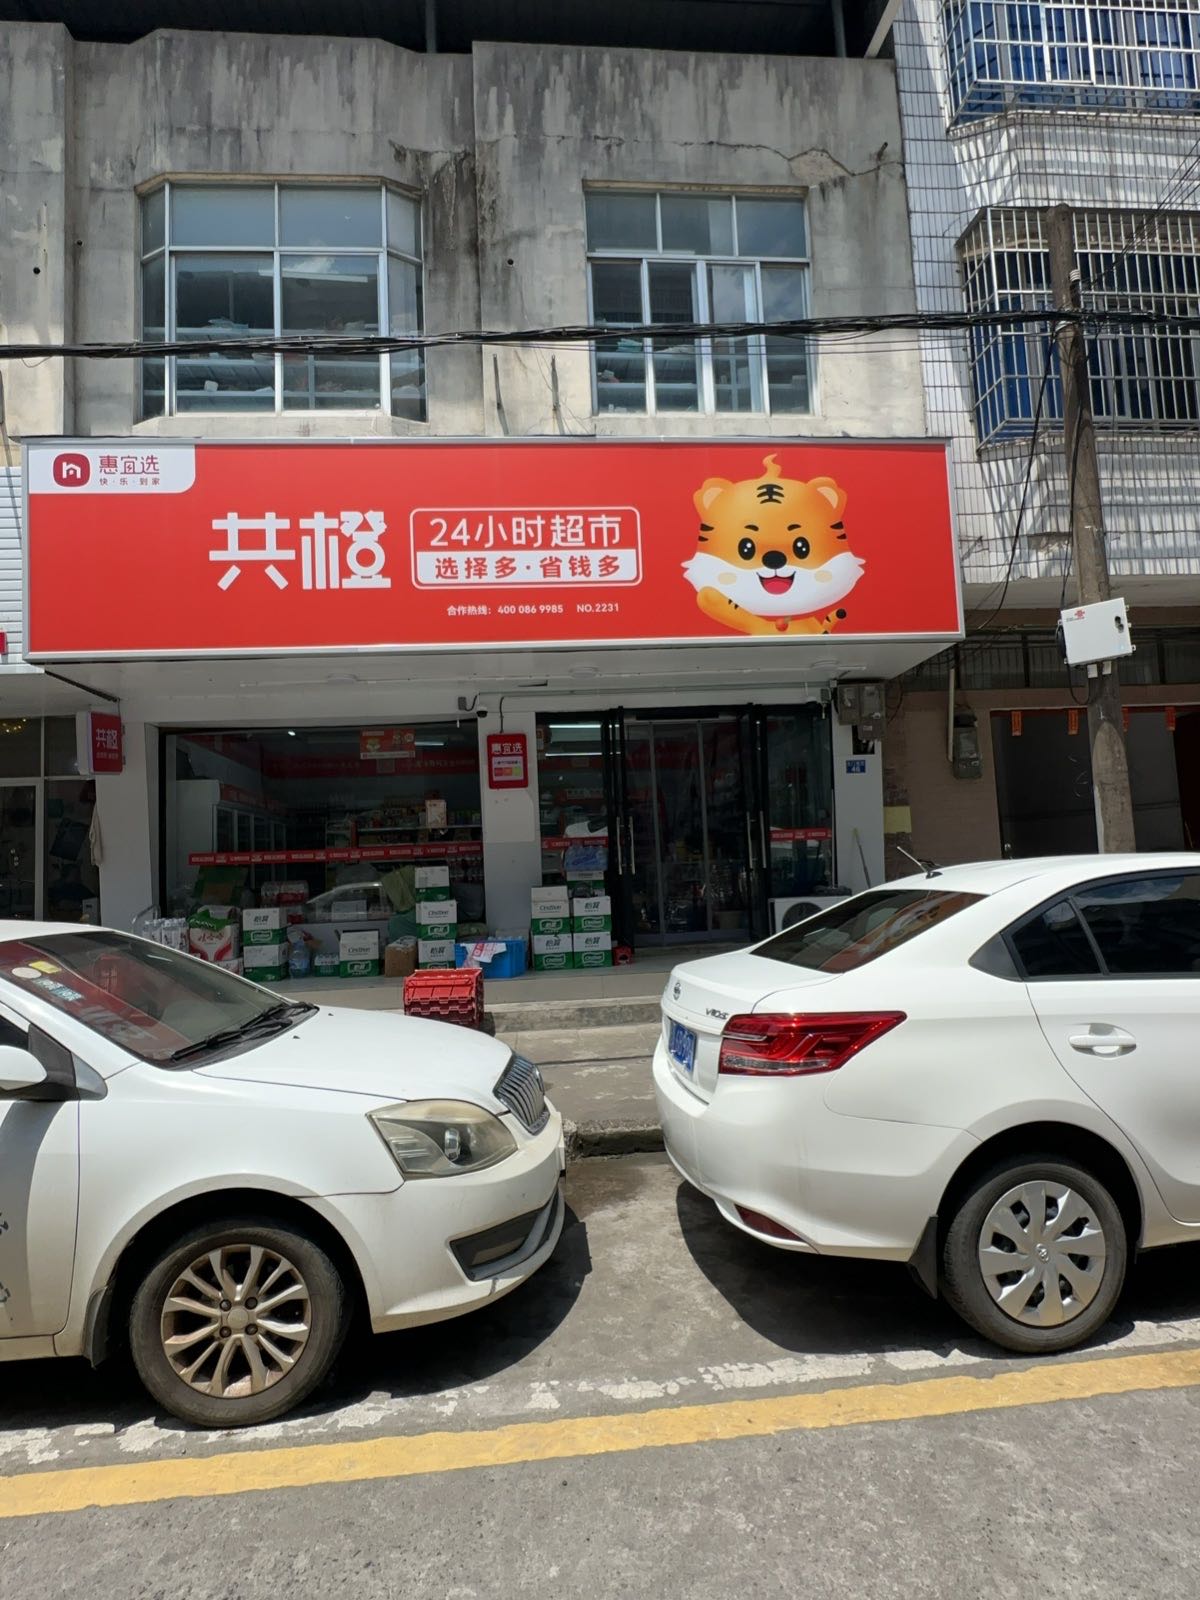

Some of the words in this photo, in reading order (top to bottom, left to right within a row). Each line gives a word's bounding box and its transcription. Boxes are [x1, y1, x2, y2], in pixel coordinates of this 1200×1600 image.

[98, 455, 160, 475] 惠宜选
[430, 515, 621, 548] 24小时超市
[209, 510, 391, 591] 共橙
[435, 555, 620, 579] 选择多·省钱多
[498, 605, 516, 614] 400
[518, 604, 537, 614] 086
[539, 604, 563, 614] 9985
[577, 603, 619, 613] NO.2231
